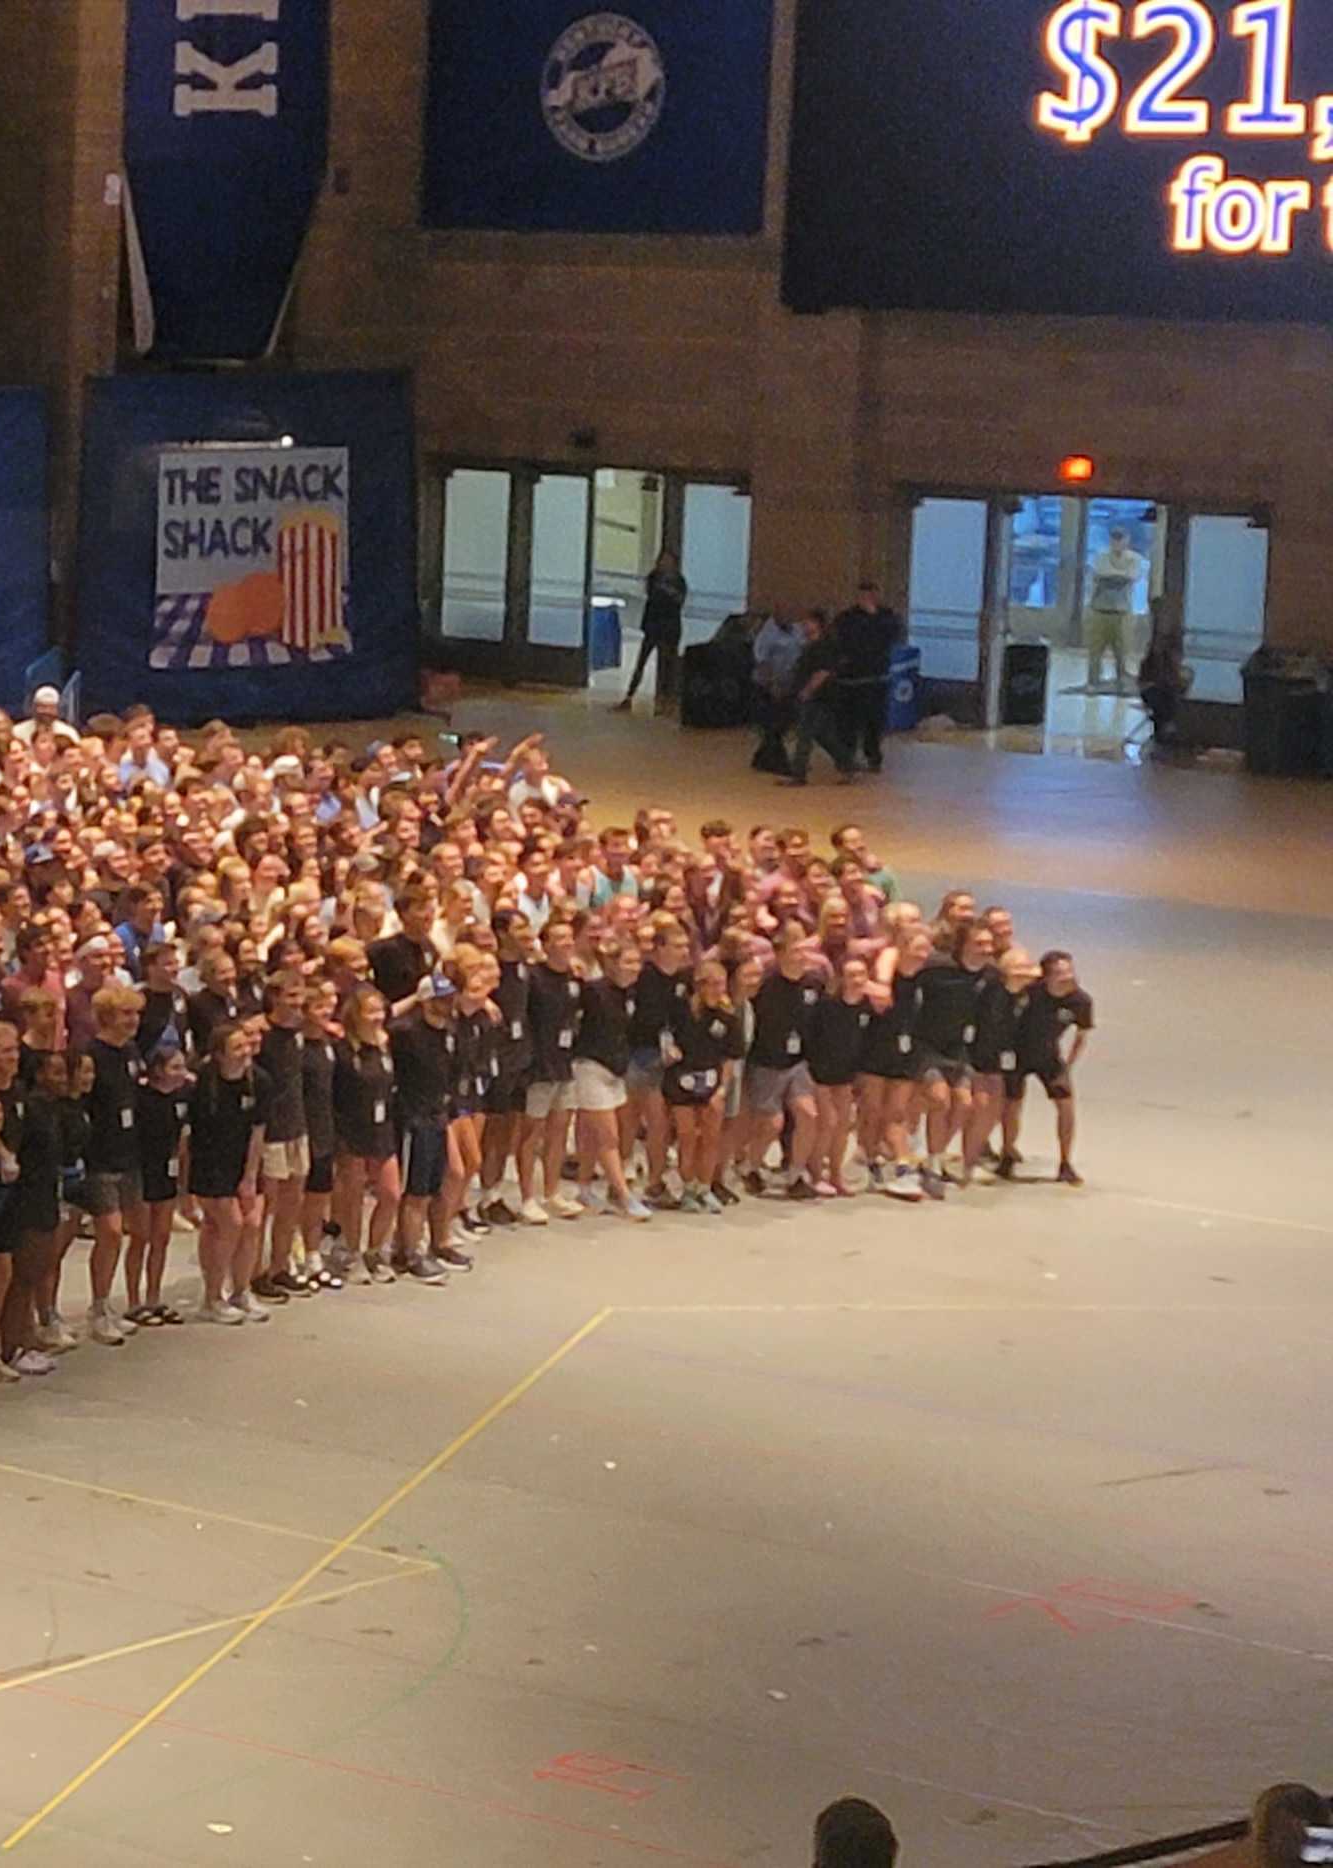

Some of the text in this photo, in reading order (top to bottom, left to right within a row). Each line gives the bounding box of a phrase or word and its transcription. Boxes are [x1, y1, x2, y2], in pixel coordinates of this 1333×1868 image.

[174, 0, 279, 117] K
[1170, 154, 1309, 252] for
[164, 464, 344, 505] THE SNACK
[163, 516, 274, 559] SHACK
